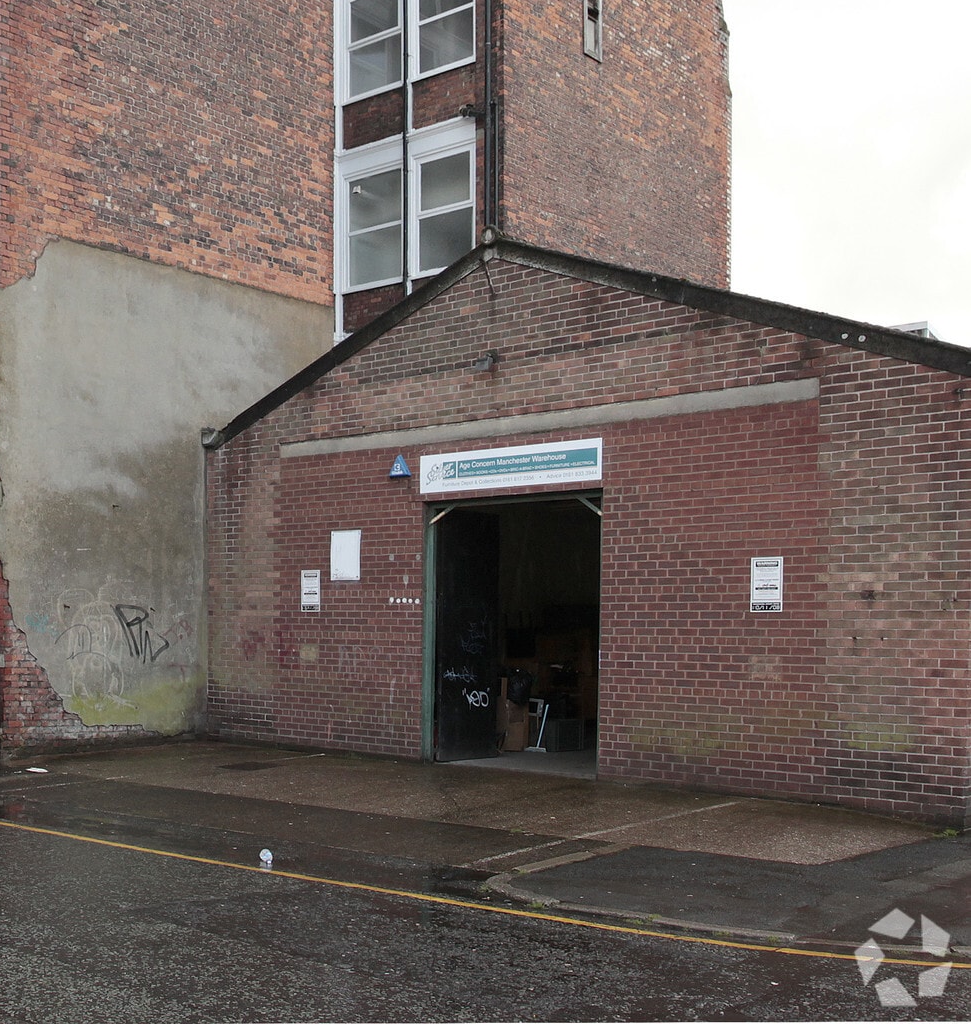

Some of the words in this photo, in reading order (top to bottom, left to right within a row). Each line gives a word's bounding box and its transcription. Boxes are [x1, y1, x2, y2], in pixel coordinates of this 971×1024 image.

[471, 460, 495, 468] Concern
[496, 456, 530, 465] Manchester
[532, 454, 567, 463] Warehouse
